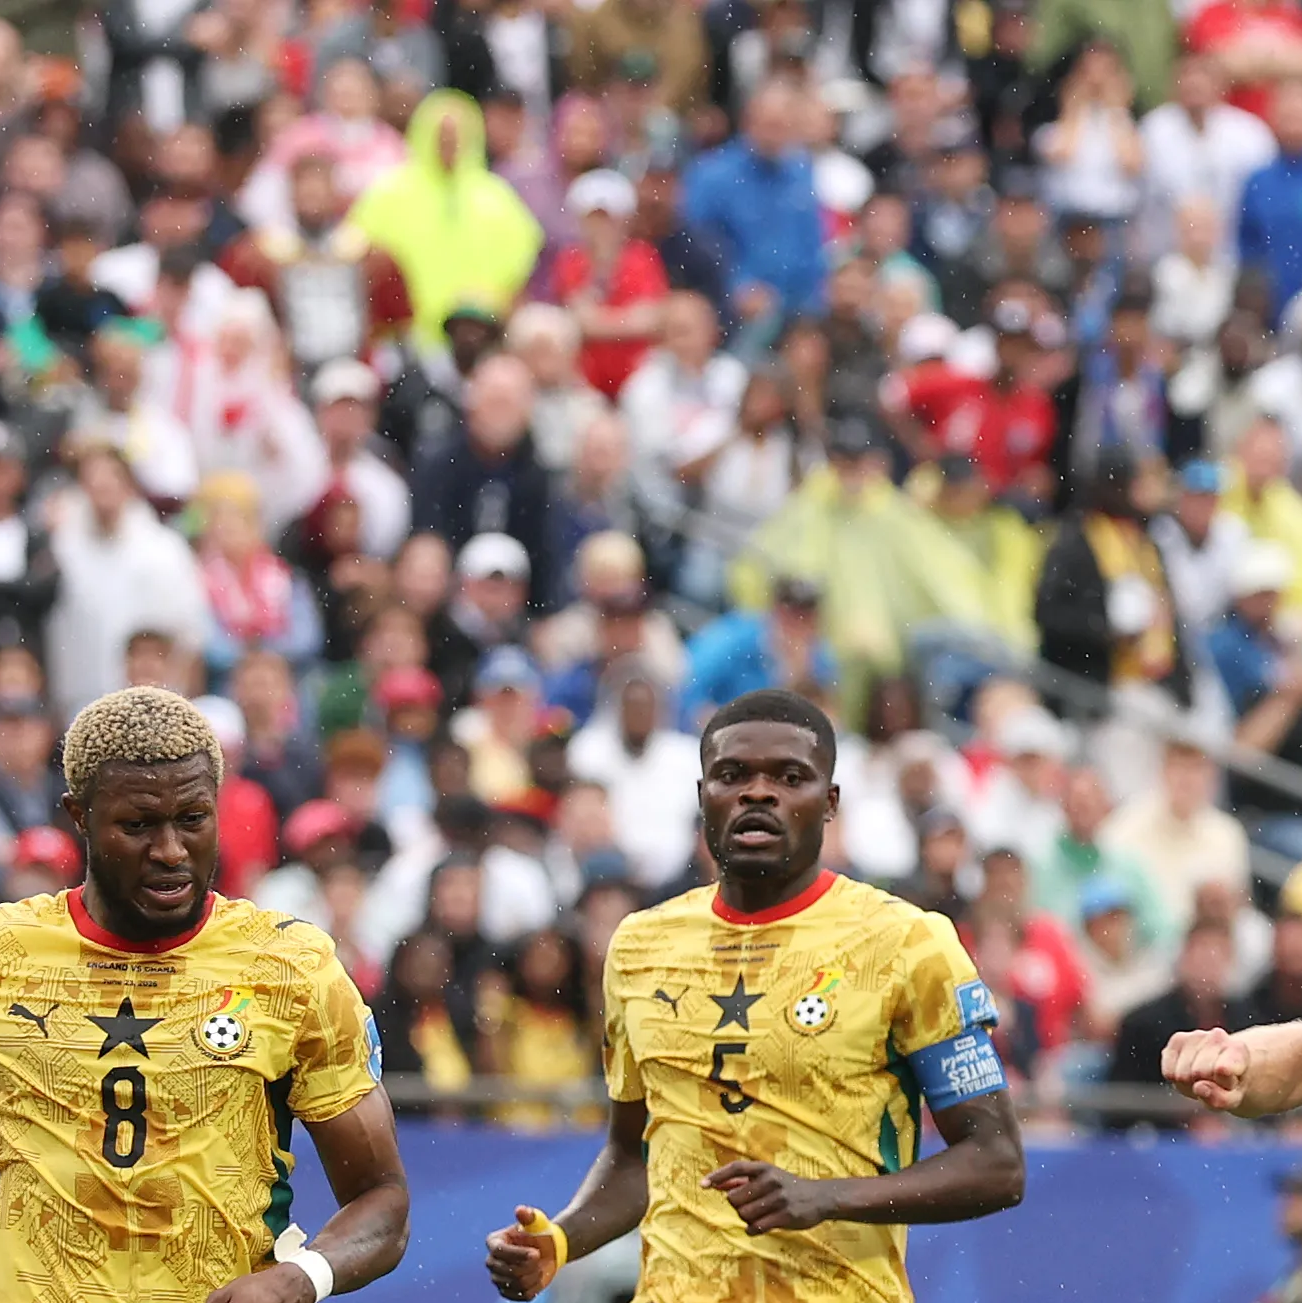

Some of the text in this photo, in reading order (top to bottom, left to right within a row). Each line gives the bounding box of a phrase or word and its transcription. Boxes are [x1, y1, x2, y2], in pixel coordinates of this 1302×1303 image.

[131, 964, 142, 973] VS
[707, 1042, 755, 1115] 5
[947, 1056, 1000, 1088] UNITES
[99, 1065, 147, 1169] 8
